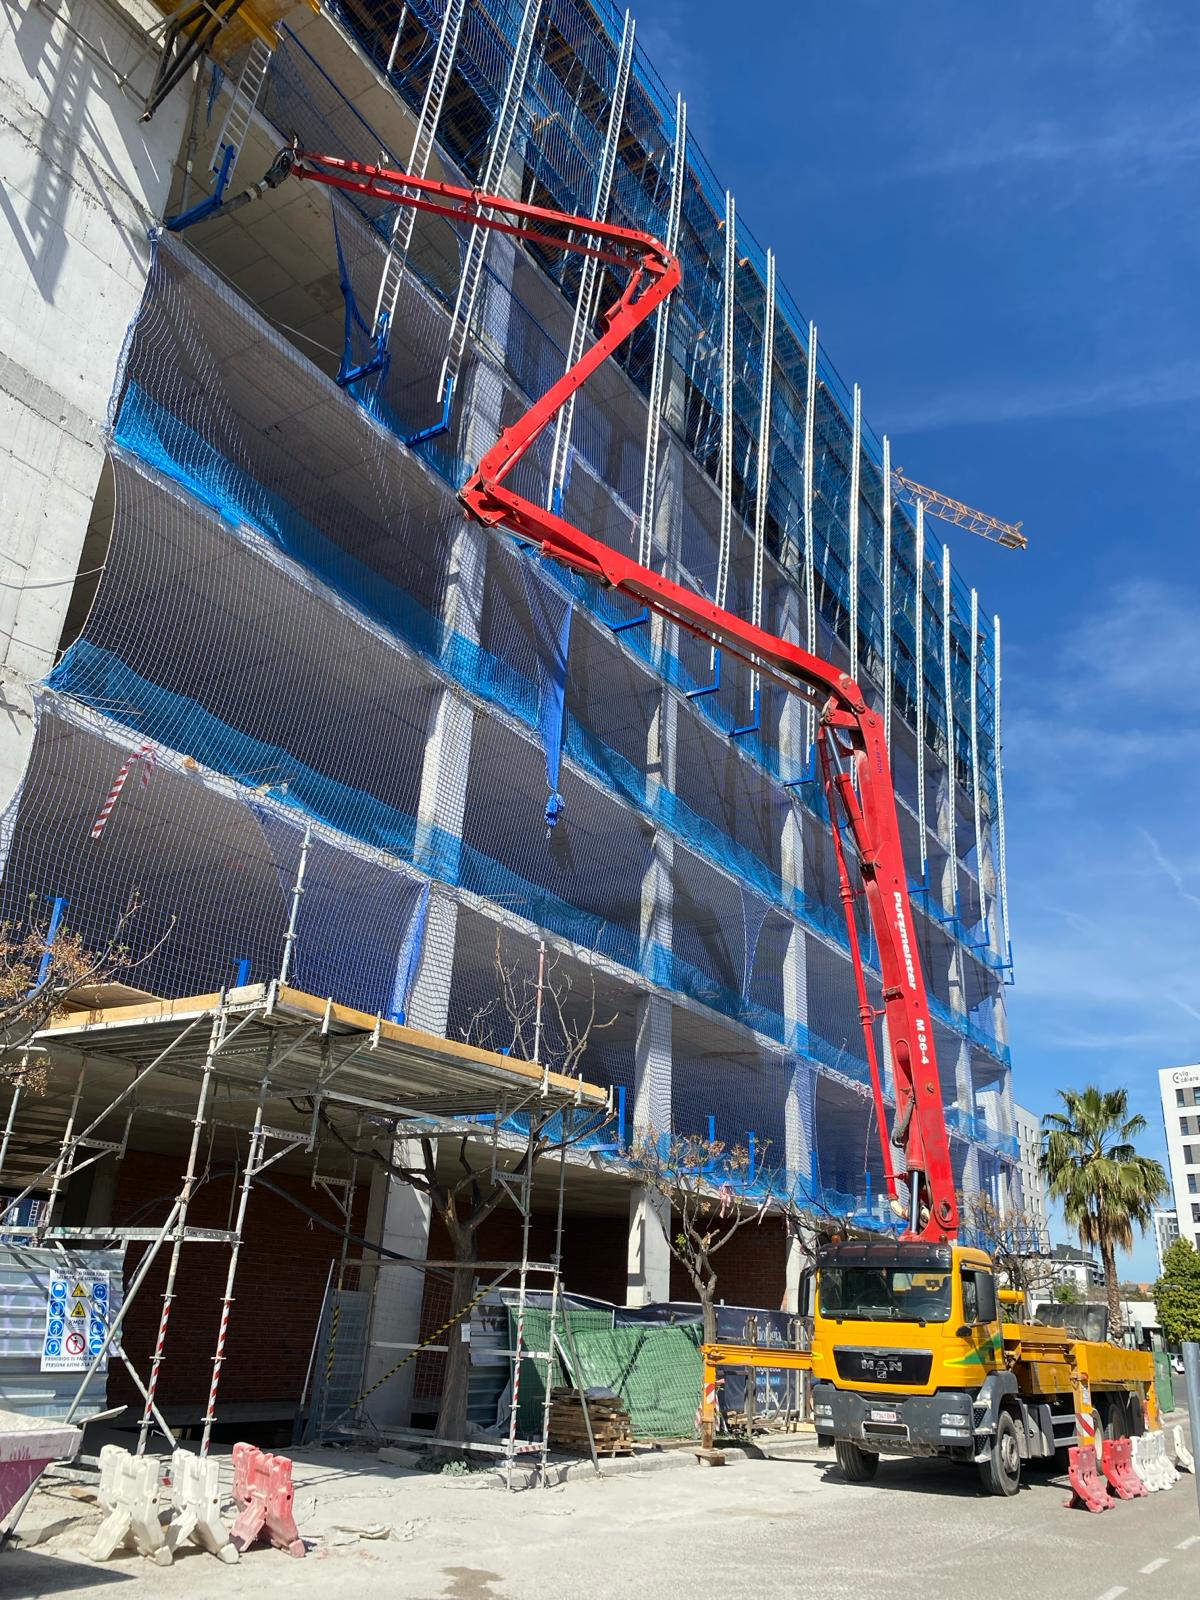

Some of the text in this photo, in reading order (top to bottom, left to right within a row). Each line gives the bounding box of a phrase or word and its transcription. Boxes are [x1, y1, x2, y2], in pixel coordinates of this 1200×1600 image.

[893, 891, 917, 990] Putzmeister
[915, 1018, 930, 1065] M 36-4
[861, 1359, 903, 1372] MAN
